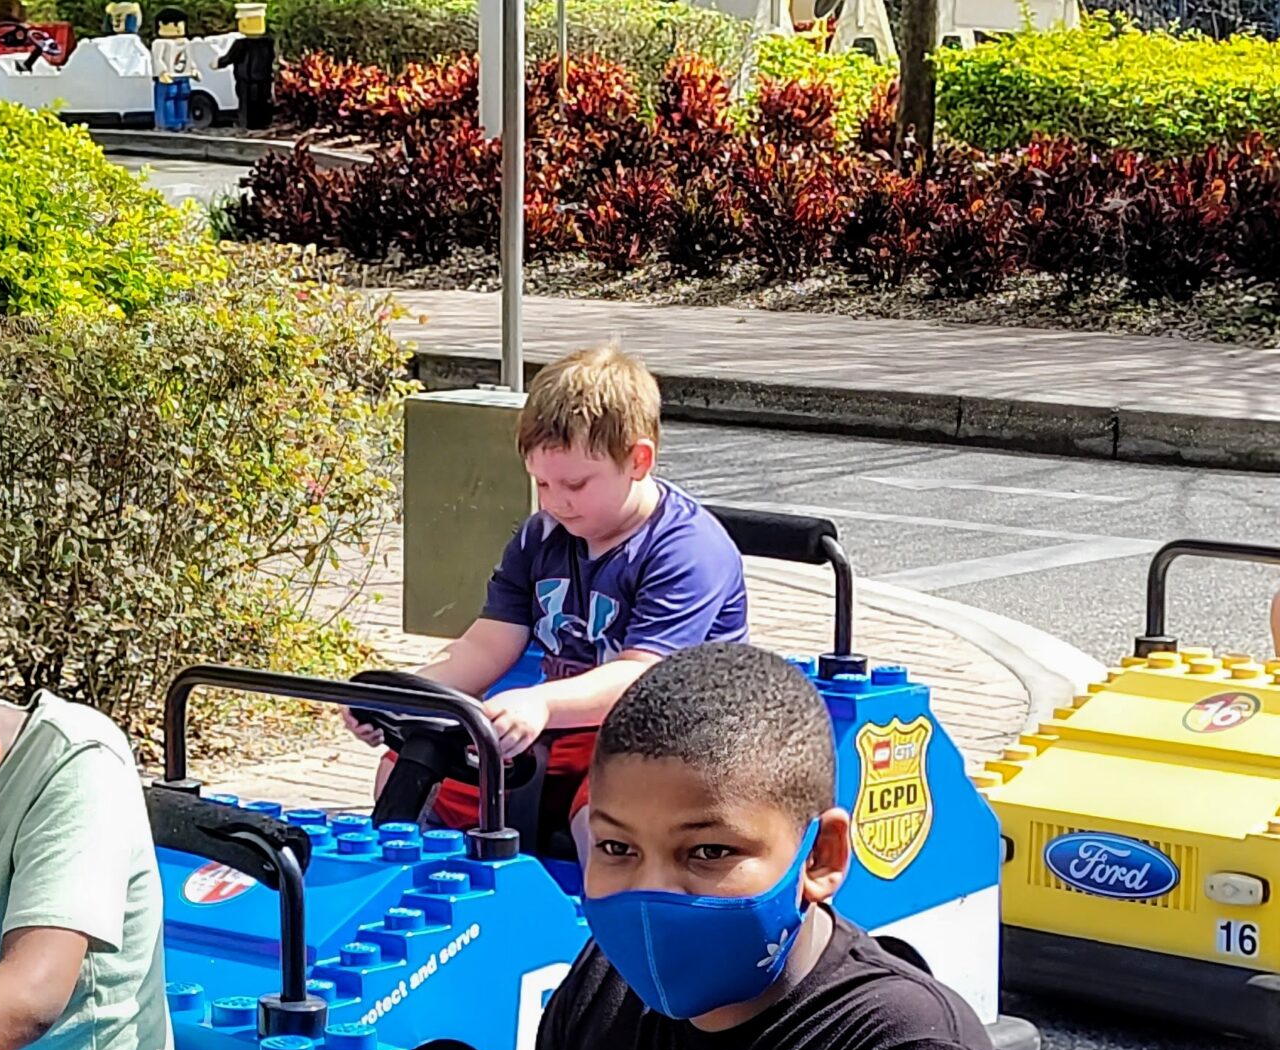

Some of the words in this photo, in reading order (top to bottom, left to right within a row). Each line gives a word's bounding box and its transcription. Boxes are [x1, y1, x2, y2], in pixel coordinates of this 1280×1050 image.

[1200, 700, 1249, 727] 16
[868, 783, 919, 814] LCPD
[862, 812, 922, 851] POLICE
[1069, 841, 1152, 890] Ford
[1219, 923, 1258, 956] 16
[358, 980, 408, 1025] rotect
[409, 953, 438, 990] and
[439, 923, 480, 964] serve
